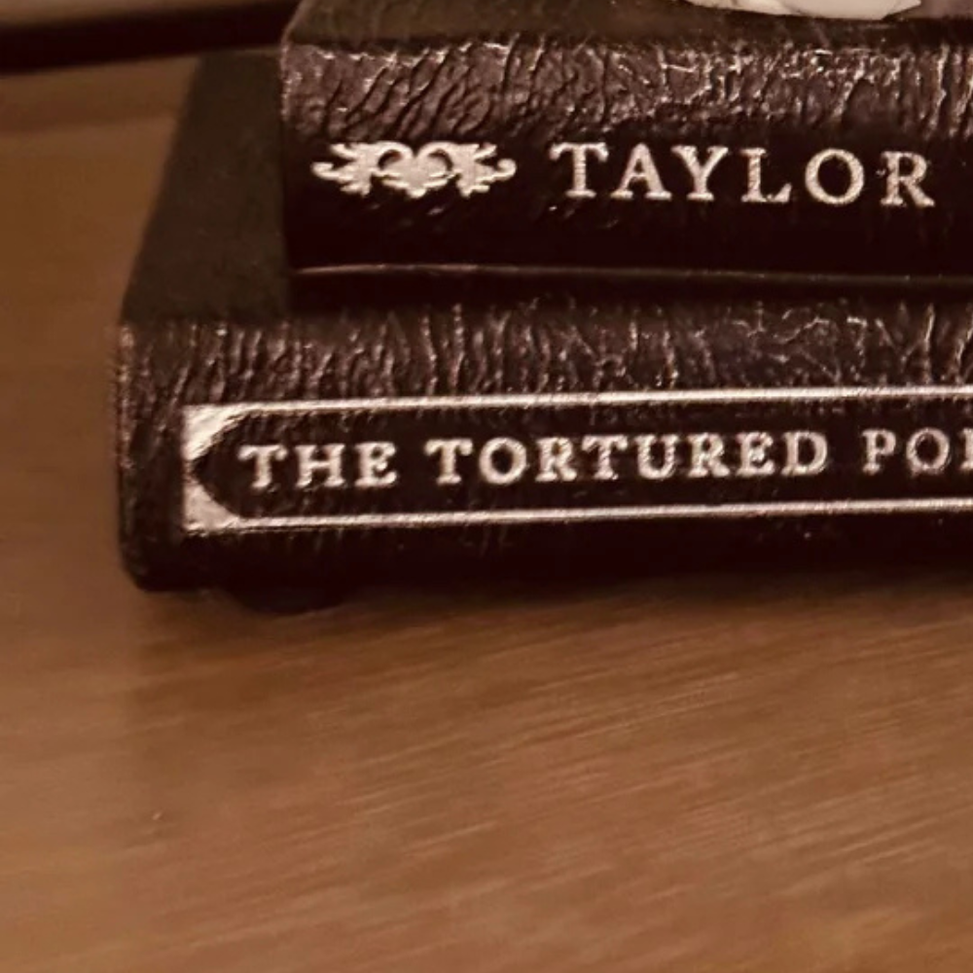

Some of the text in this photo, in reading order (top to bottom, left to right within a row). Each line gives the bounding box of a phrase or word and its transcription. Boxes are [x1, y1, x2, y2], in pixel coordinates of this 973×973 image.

[551, 142, 934, 209] TAYLOR
[240, 442, 396, 488] THE
[426, 432, 827, 484] TORTURED
